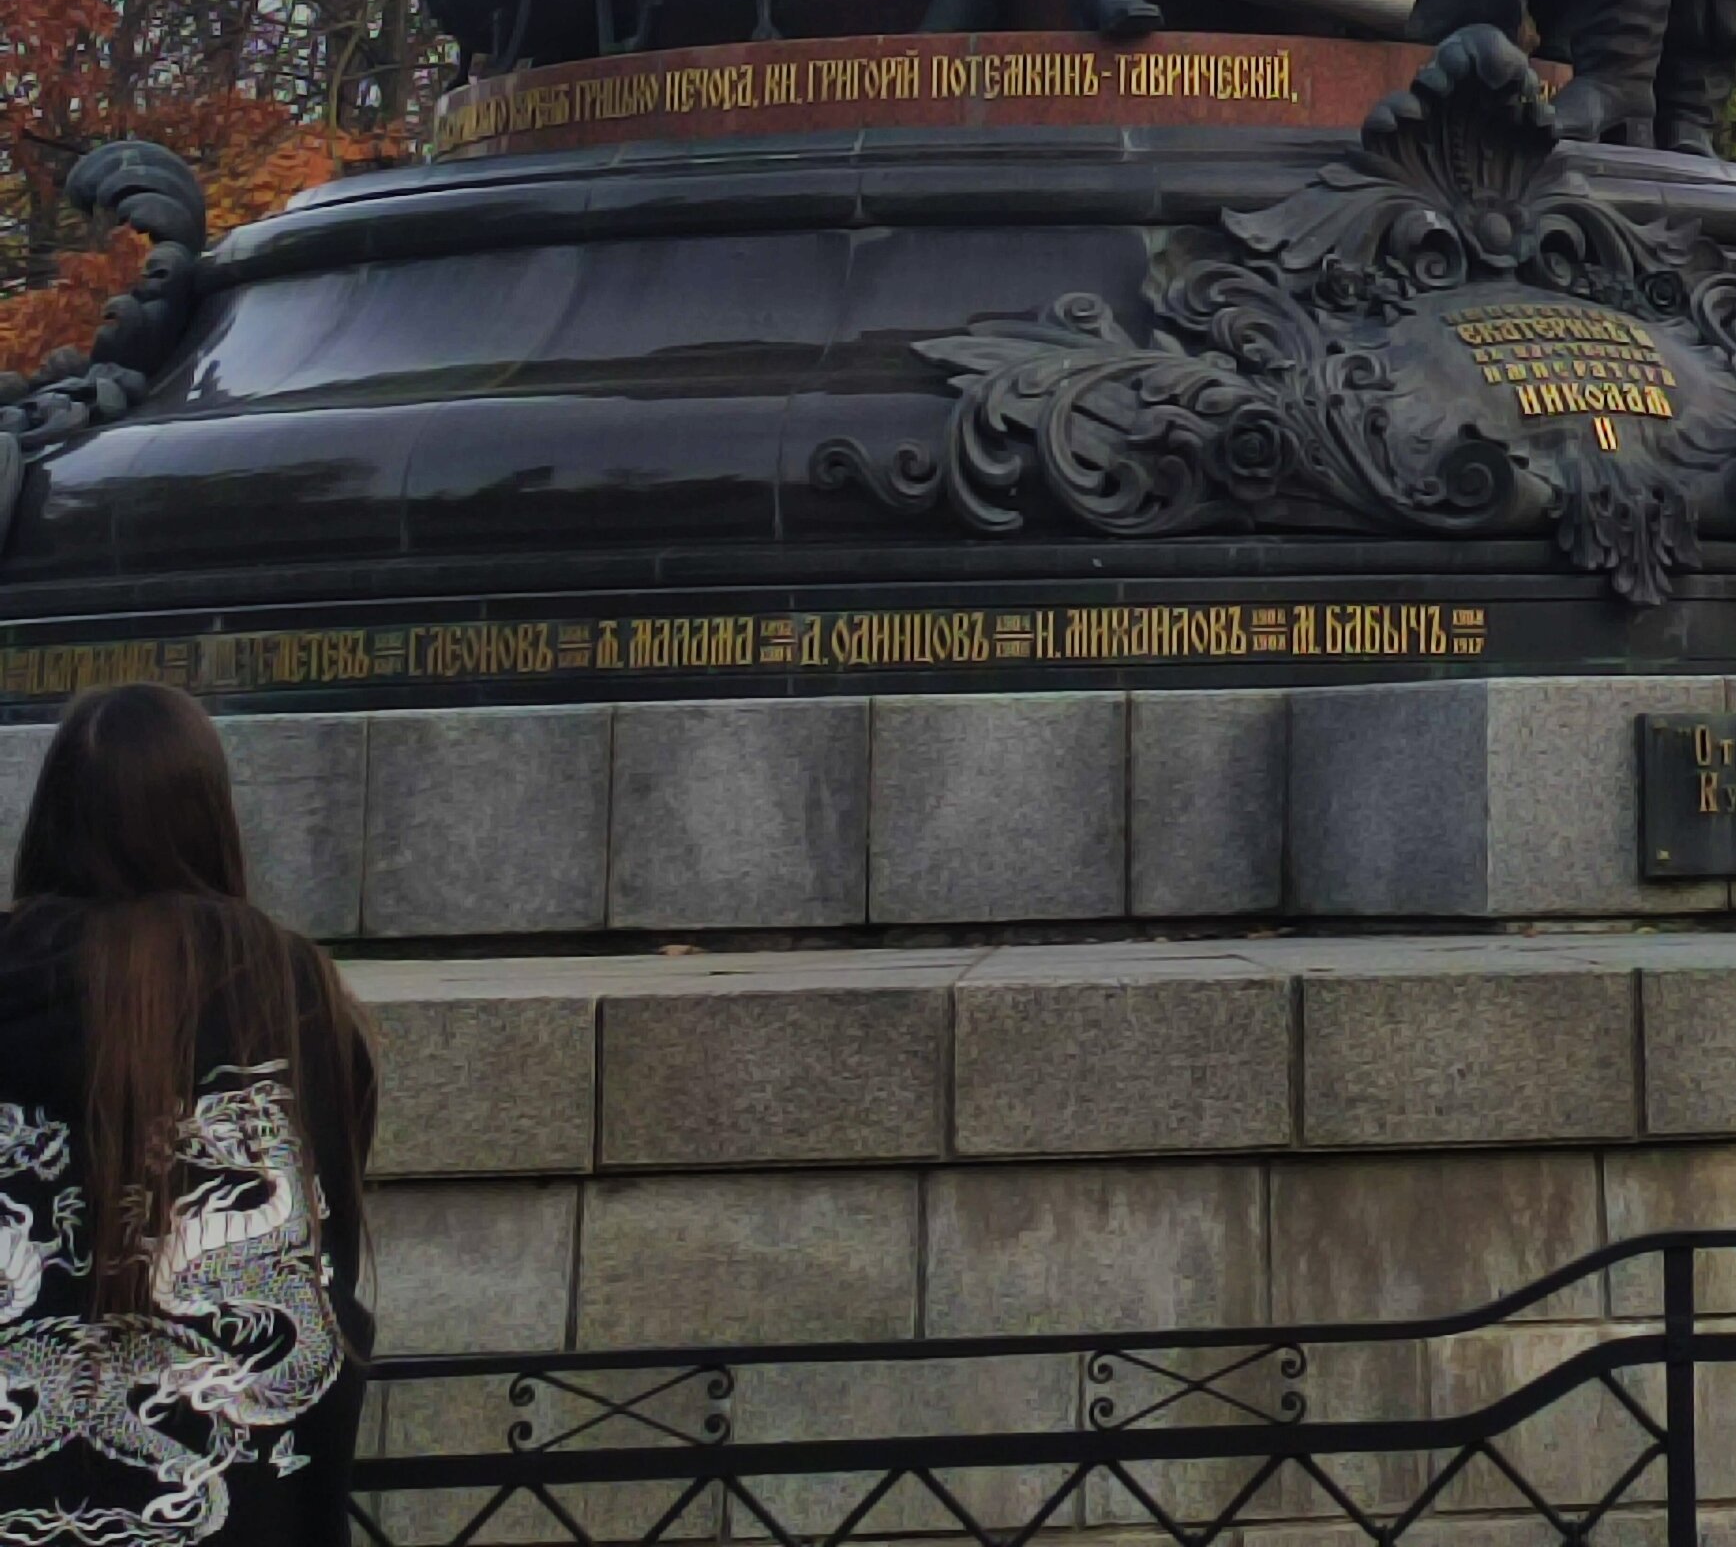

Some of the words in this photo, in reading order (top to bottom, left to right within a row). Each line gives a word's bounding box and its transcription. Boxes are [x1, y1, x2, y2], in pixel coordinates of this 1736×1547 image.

[629, 616, 753, 669] МАЛАМА
[1036, 610, 1062, 659] Н.
[1325, 605, 1447, 655] БАБЫЧЪ
